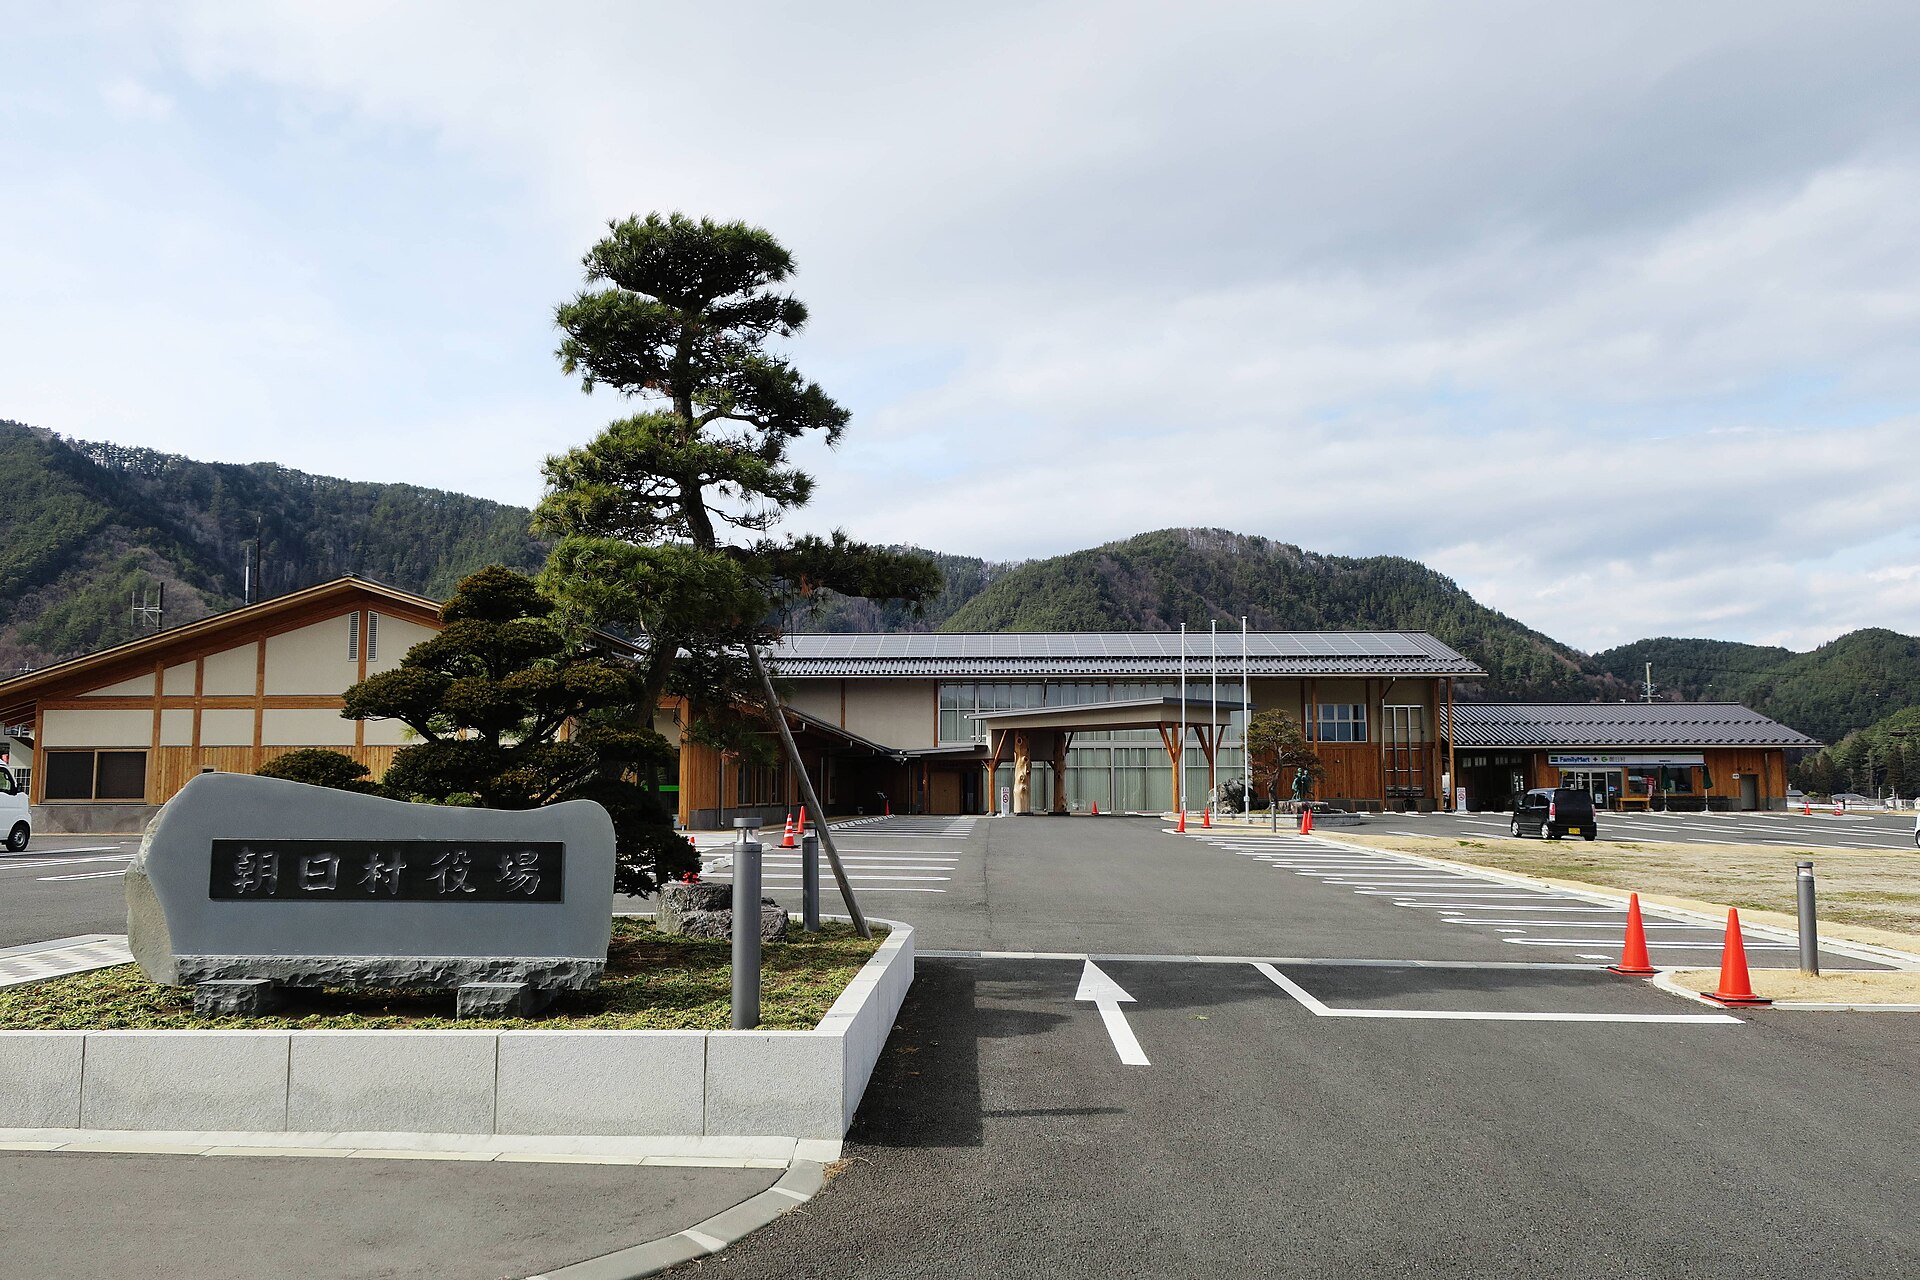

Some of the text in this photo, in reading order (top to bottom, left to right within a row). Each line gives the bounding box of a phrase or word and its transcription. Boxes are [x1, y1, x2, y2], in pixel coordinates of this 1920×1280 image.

[231, 847, 541, 895] 朝日村役場
